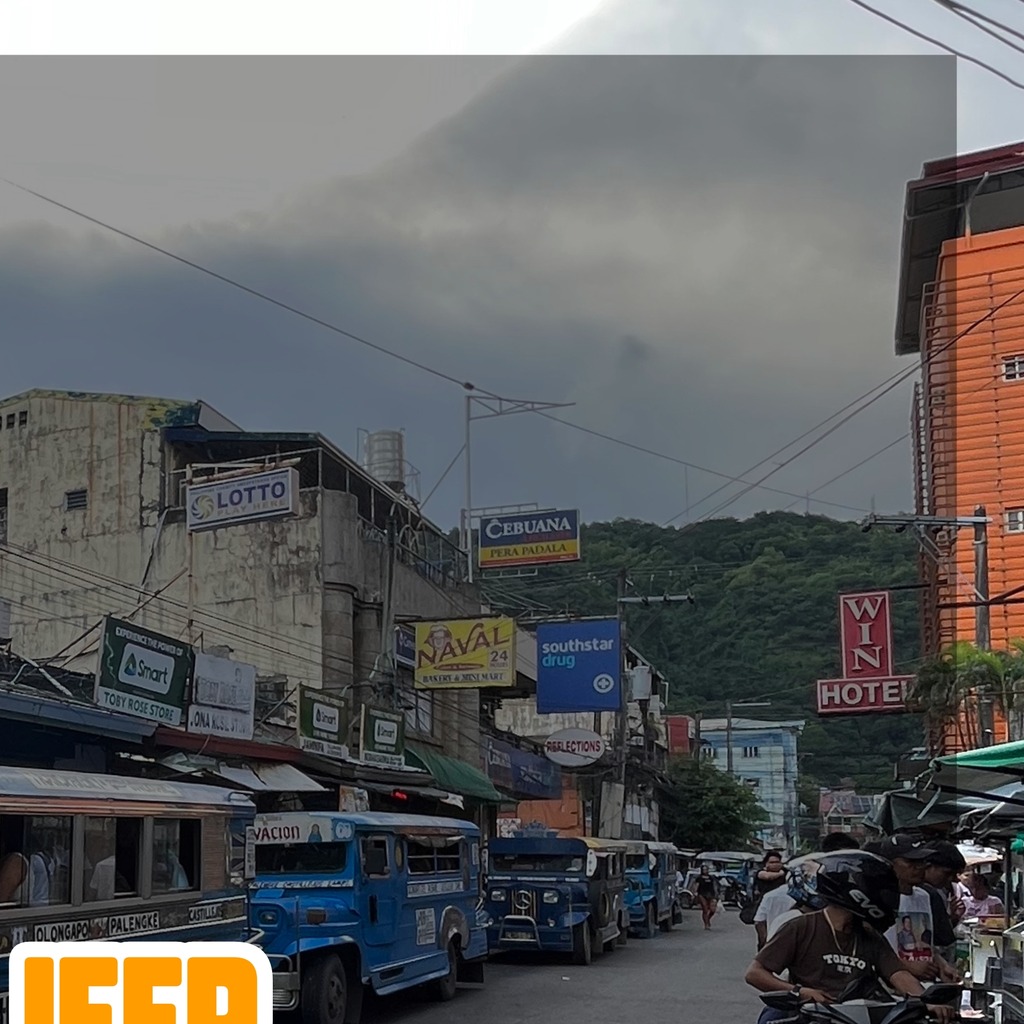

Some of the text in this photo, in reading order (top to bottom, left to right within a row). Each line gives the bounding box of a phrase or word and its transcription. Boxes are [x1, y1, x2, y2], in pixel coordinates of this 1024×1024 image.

[217, 481, 286, 509] LOTTO
[217, 500, 286, 516] PLAY HERE
[485, 516, 572, 540] CEBUANA
[490, 543, 567, 559] PERA PADALA
[115, 626, 148, 645] EXPERIENCE
[843, 595, 886, 671] WIN
[417, 622, 511, 670] NAVAL
[542, 637, 614, 654] southstar
[490, 650, 509, 662] 24
[541, 653, 576, 669] drug
[137, 660, 169, 685] Smart
[423, 673, 504, 684] BAKERY & MINI MART
[104, 691, 128, 707] TOBY
[128, 697, 148, 714] ROSE
[149, 703, 175, 722] STORE
[321, 711, 337, 725] Smart
[546, 740, 602, 753] REFLECTIONS
[255, 825, 301, 841] VACION
[848, 889, 885, 919] EVO
[36, 921, 89, 942] OLONGAPO
[109, 912, 159, 935] PALENGKE
[822, 953, 867, 970] TOKYO
